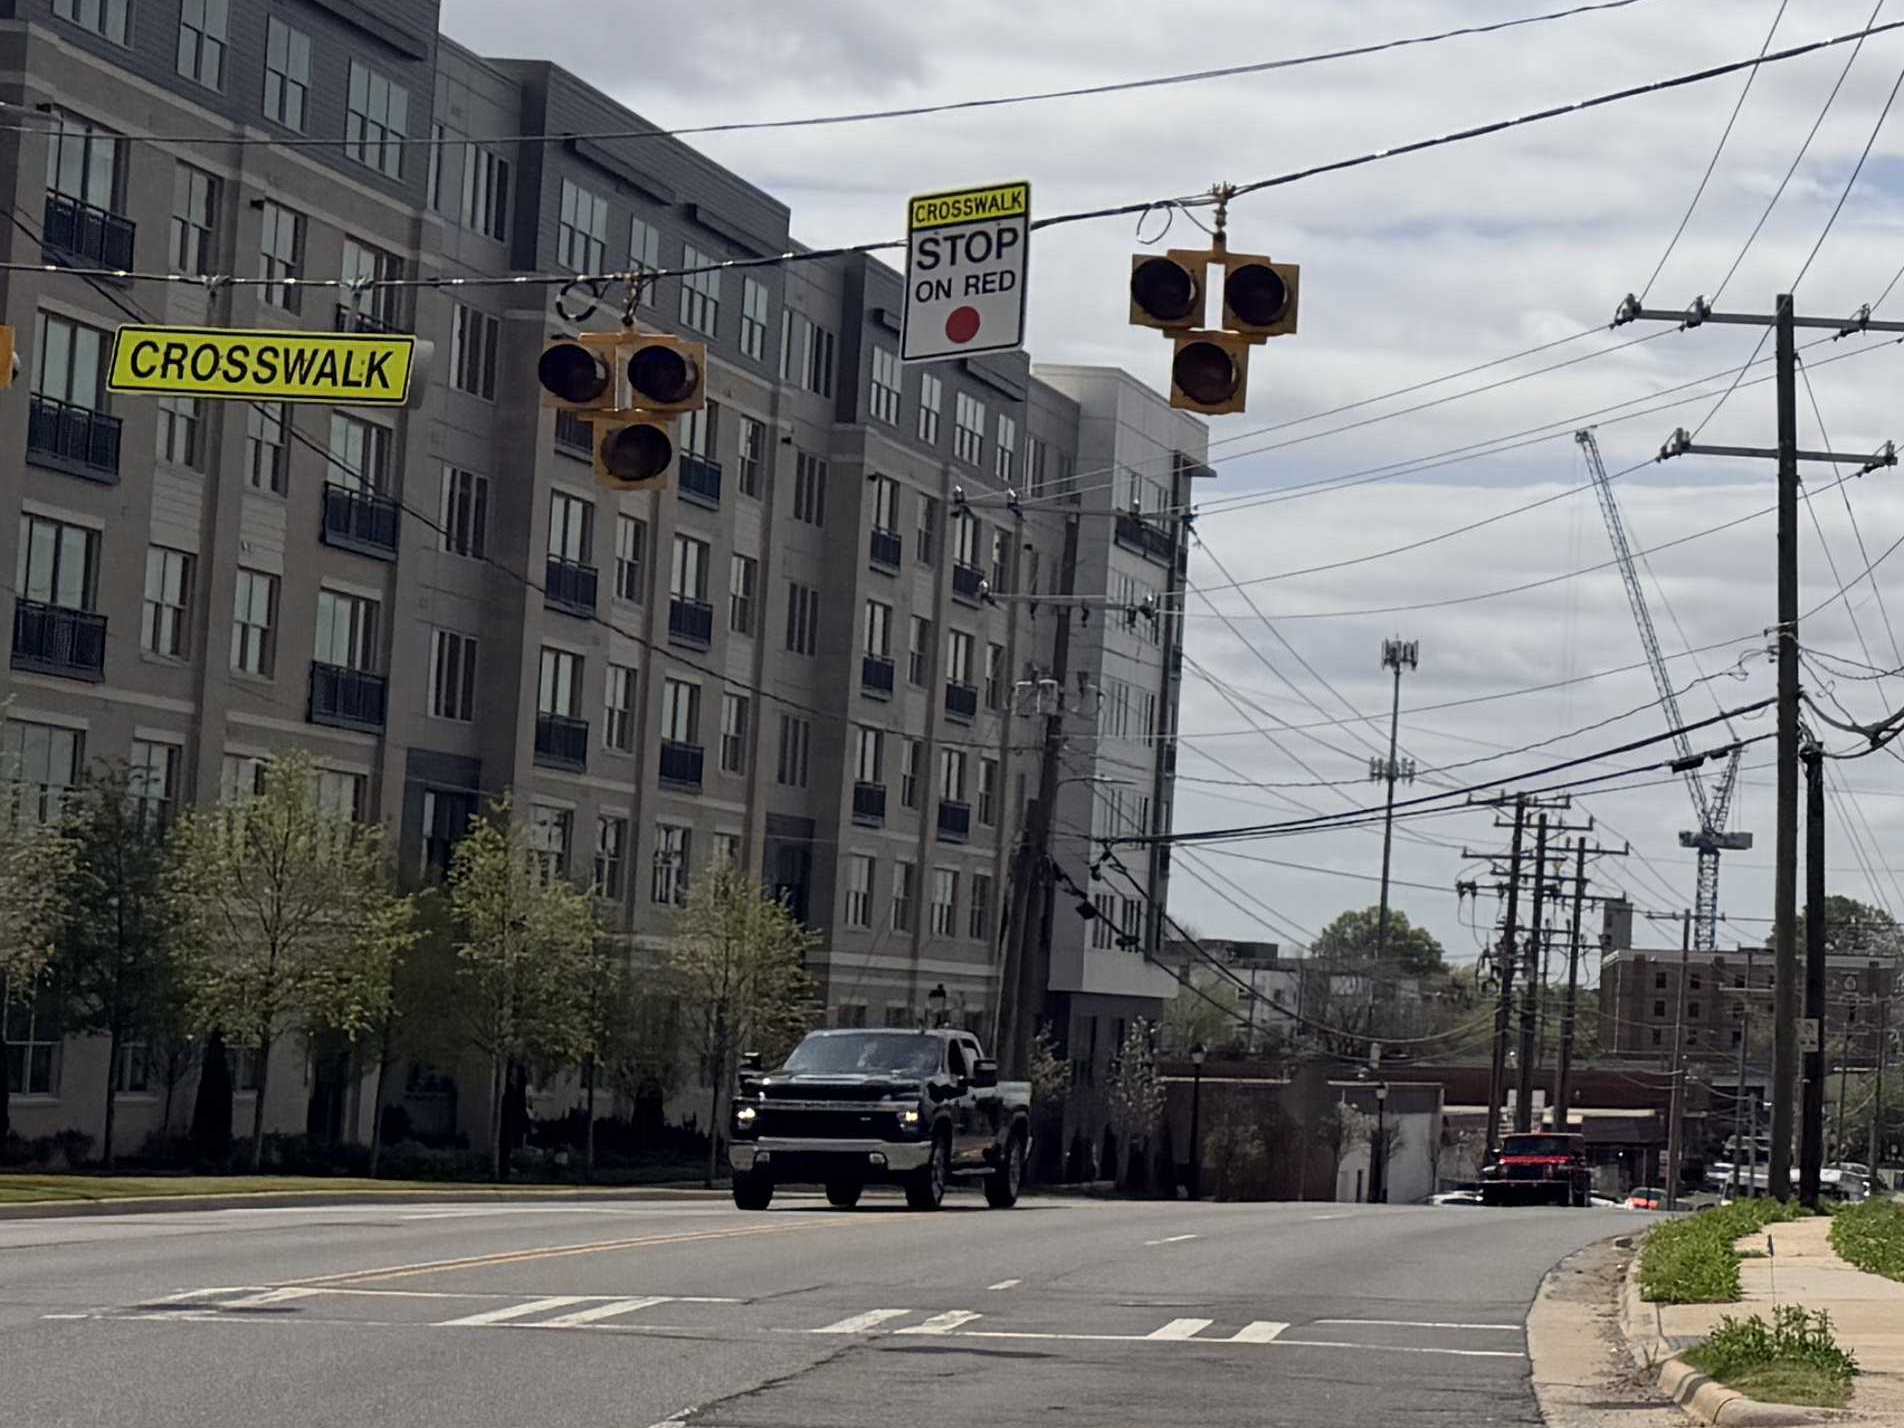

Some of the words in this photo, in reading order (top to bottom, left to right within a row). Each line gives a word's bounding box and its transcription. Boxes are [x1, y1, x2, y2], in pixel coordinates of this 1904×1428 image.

[915, 191, 1022, 223] CROSSWALK
[916, 227, 1019, 270] STOP
[915, 278, 952, 303] ON
[964, 270, 1016, 296] RED
[130, 340, 394, 389] CROSSWALK
